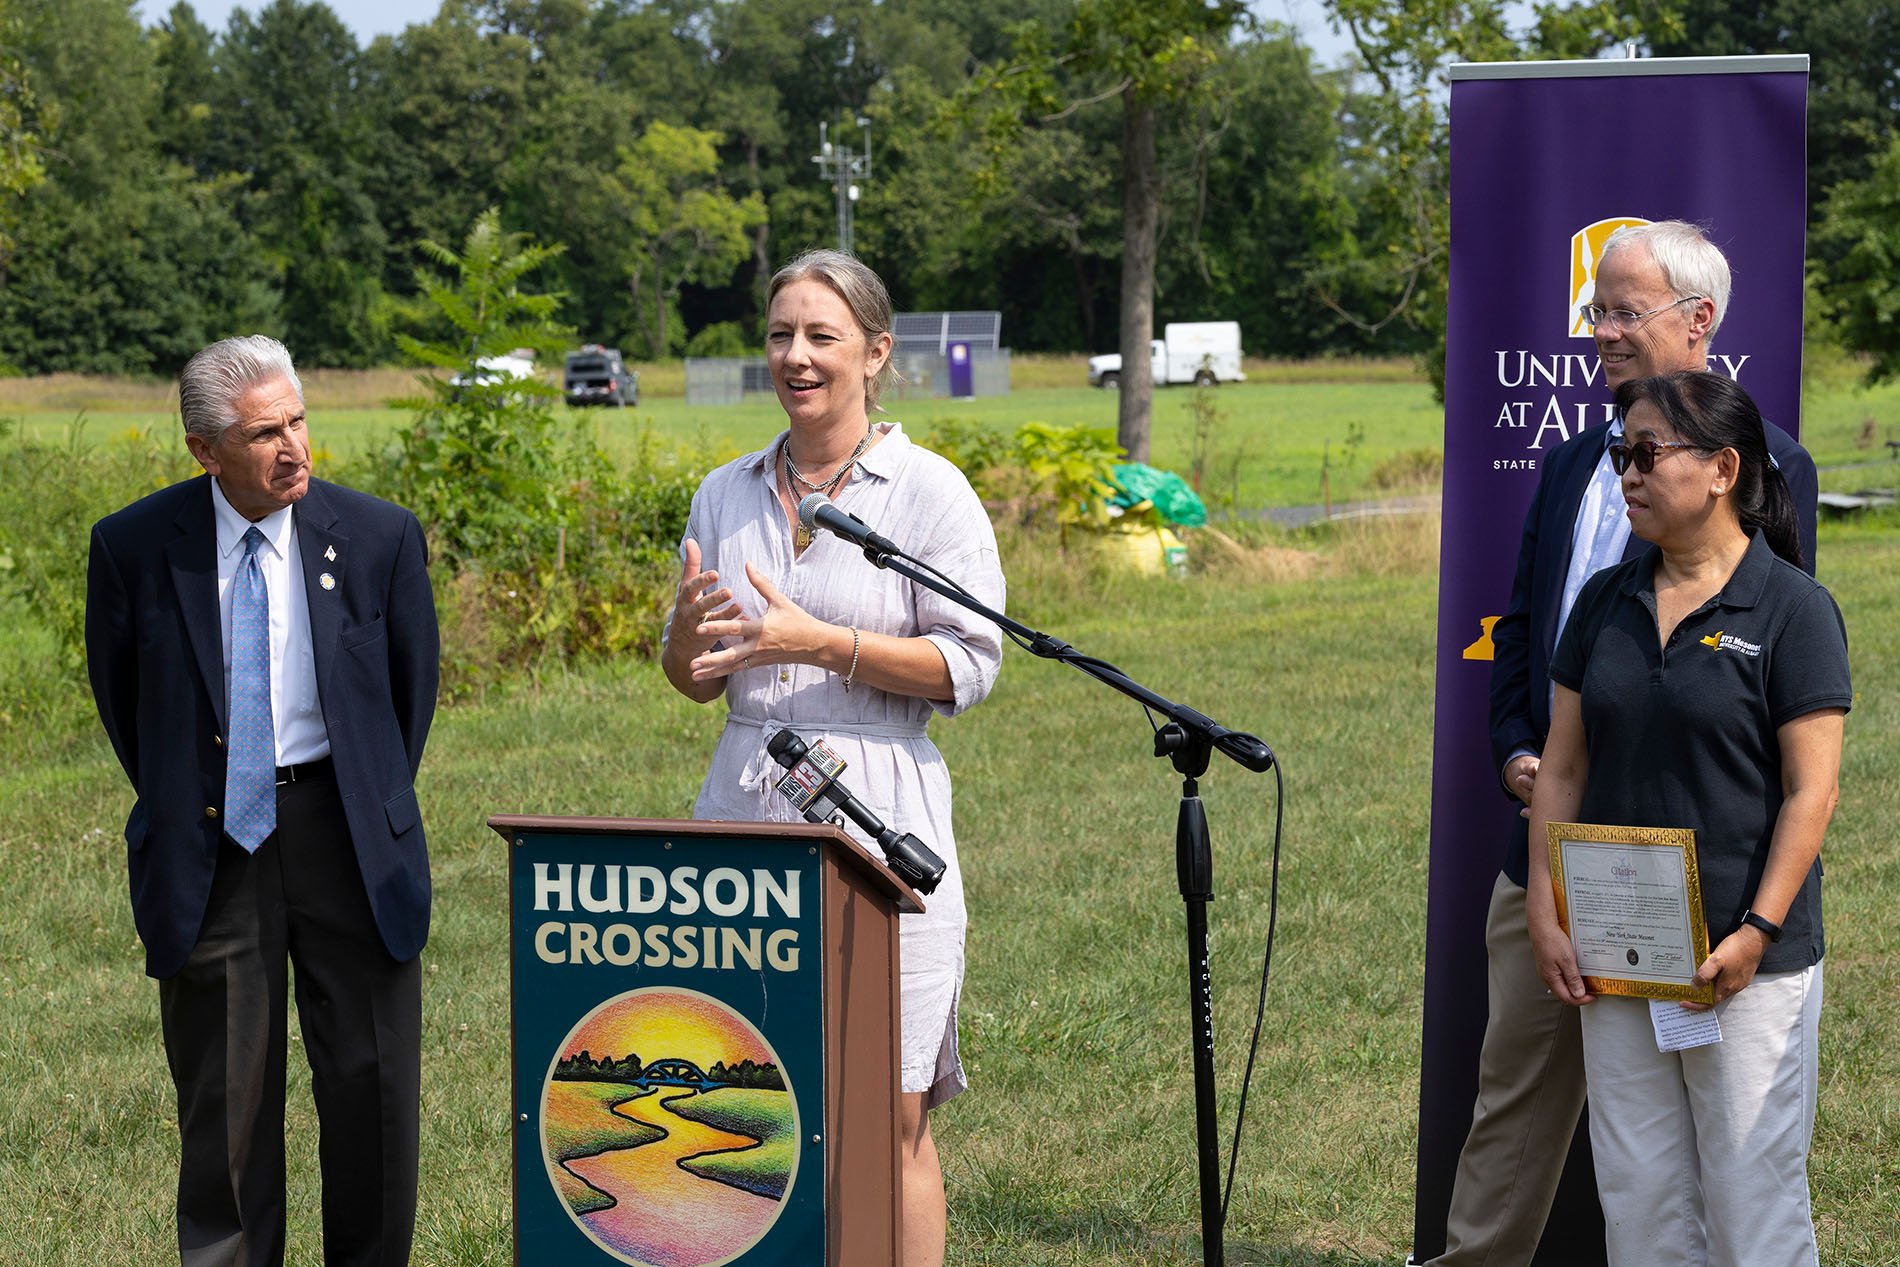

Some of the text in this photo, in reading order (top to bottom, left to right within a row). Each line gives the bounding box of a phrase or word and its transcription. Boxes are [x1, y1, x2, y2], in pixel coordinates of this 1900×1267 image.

[1495, 350, 1751, 388] UNIVY
[1494, 402, 1533, 428] AT
[1493, 459, 1536, 470] STATE
[1734, 637, 1761, 651] Mesonet
[794, 761, 824, 792] 13
[533, 862, 802, 918] HUDSON
[534, 921, 801, 972] CROSSING
